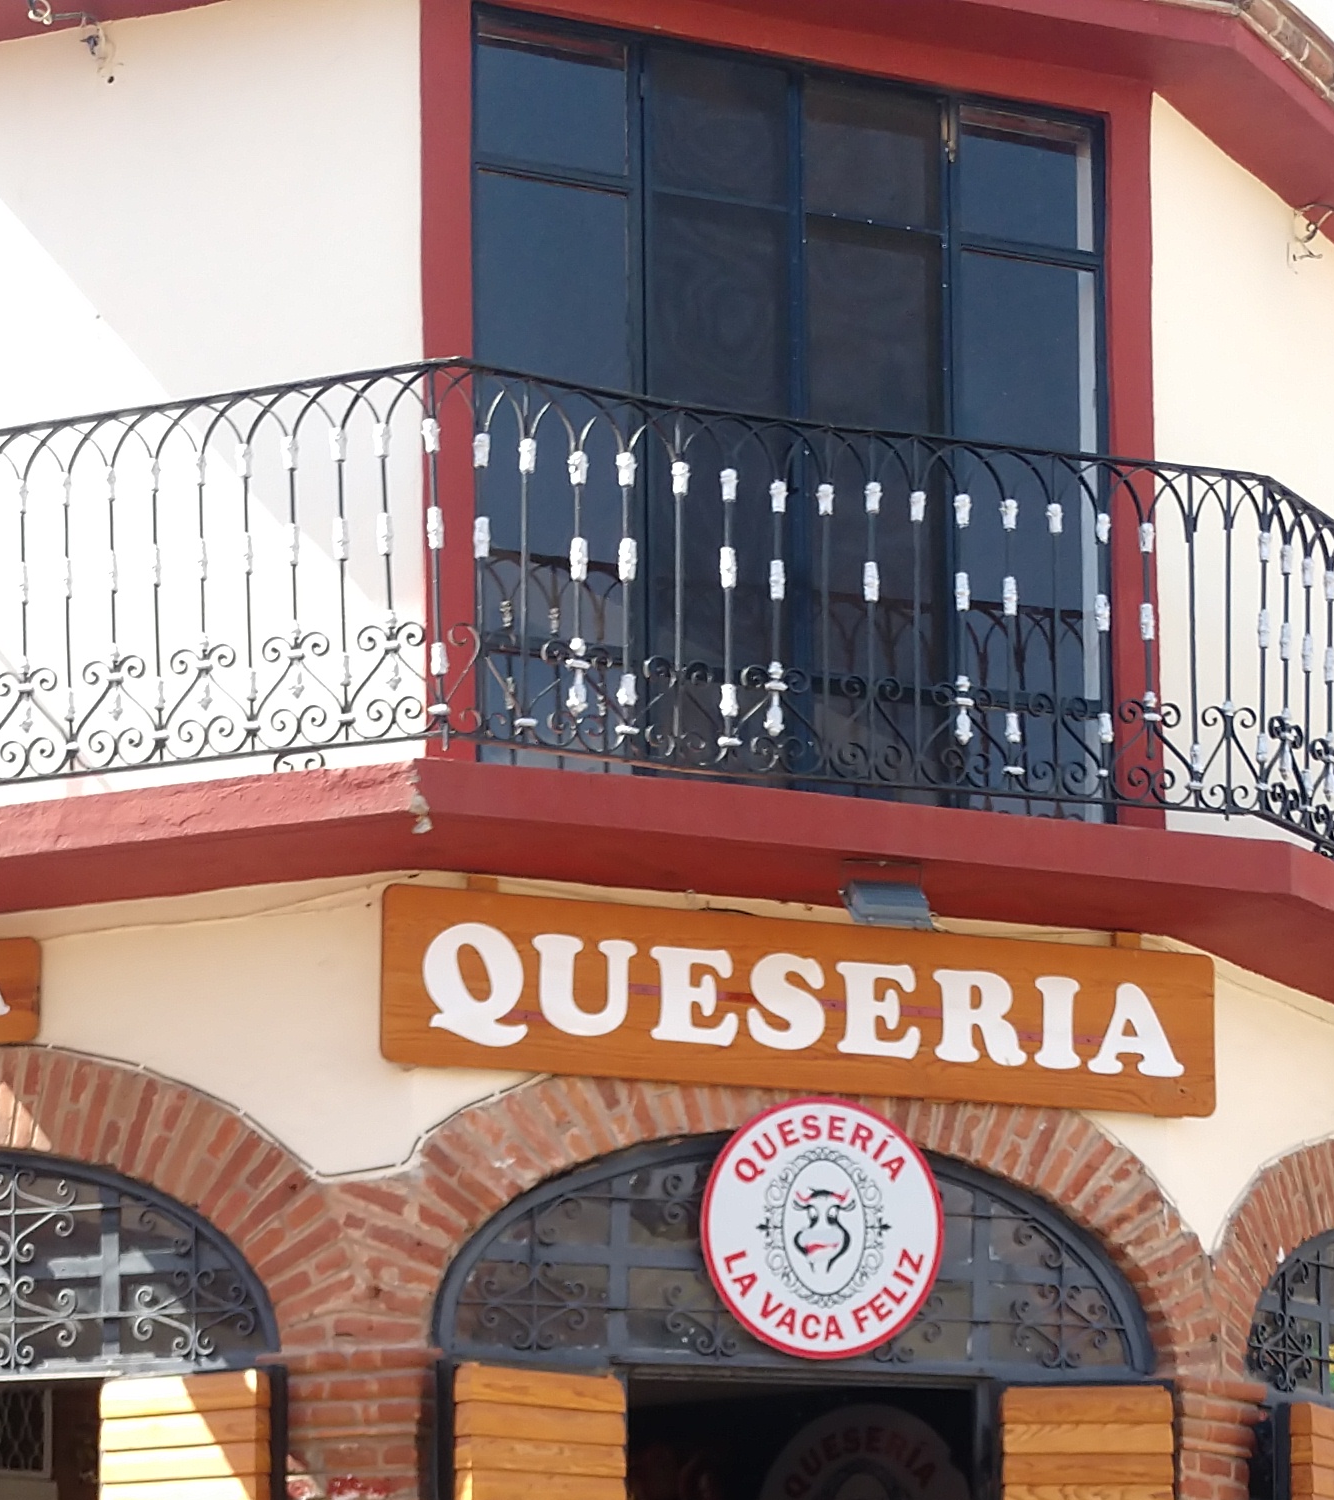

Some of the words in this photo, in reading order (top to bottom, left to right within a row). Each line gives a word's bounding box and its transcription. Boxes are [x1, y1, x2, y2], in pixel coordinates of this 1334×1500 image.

[422, 921, 1186, 1077] QUESERIA
[733, 1114, 907, 1184] QUESERÍA
[723, 1249, 760, 1299] LA
[759, 1291, 845, 1342] VACA
[851, 1248, 925, 1334] FELIZ
